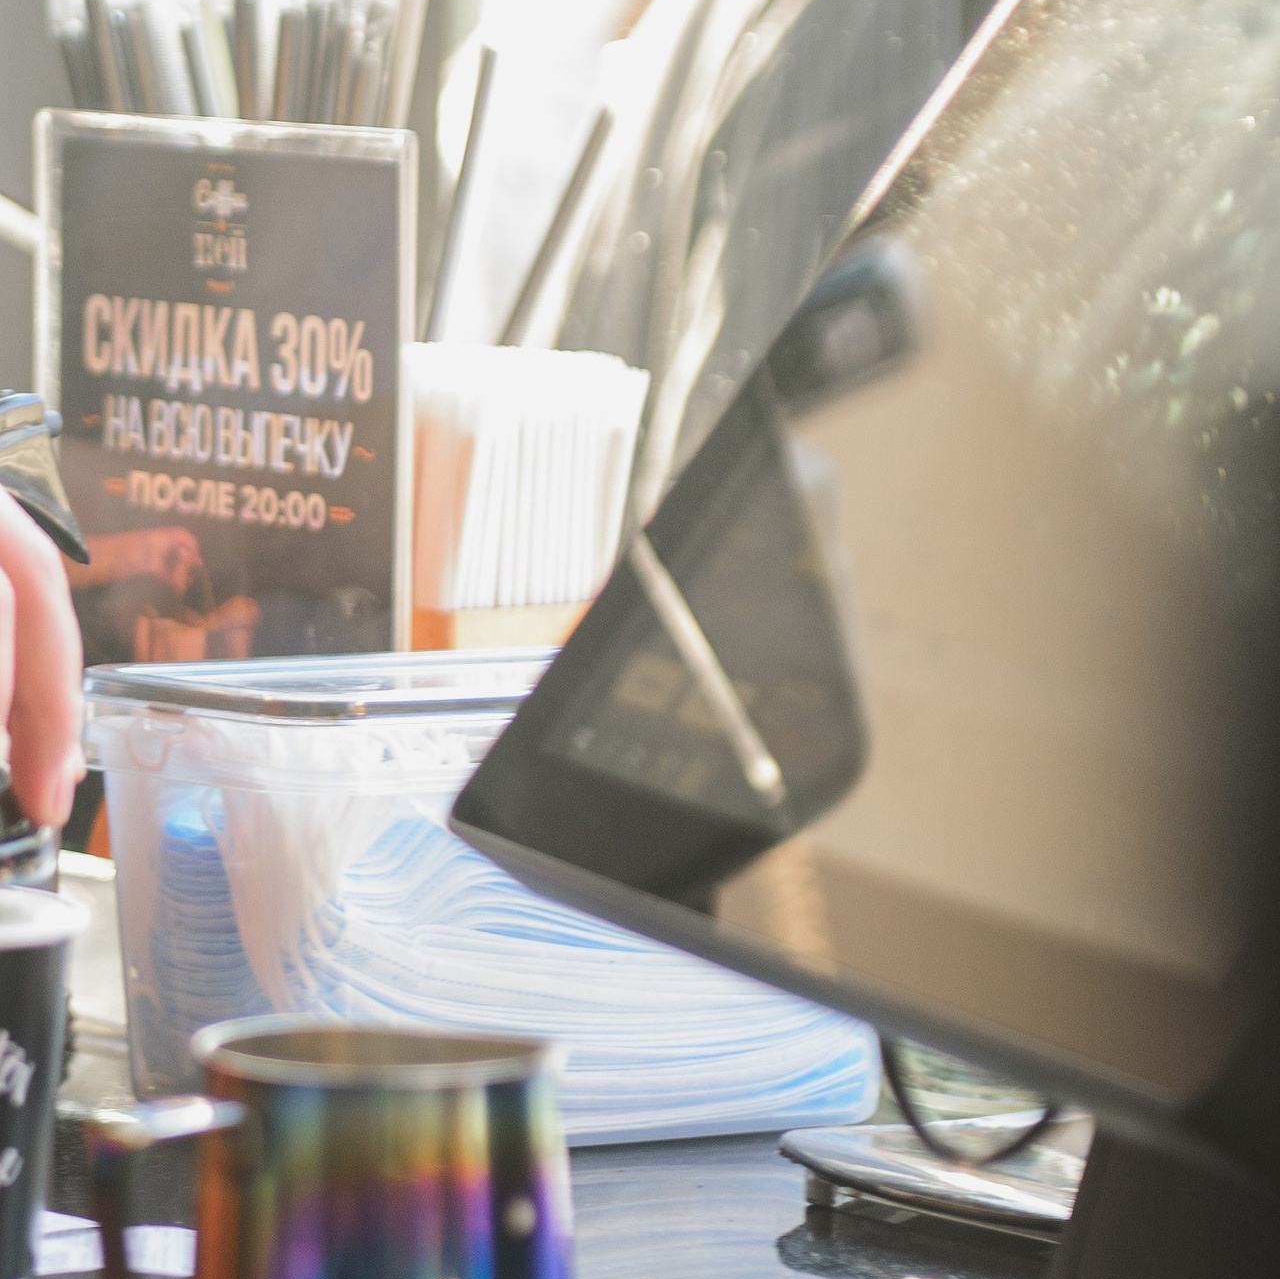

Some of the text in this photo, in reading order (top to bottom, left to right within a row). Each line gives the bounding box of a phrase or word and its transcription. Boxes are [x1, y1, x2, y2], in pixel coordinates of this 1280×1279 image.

[83, 293, 374, 404] СКИДКА 30%
[103, 394, 355, 479] НА ВСЮ ВЫПЕЧКУ
[129, 470, 328, 530] ПОСЛЕ 20:00
